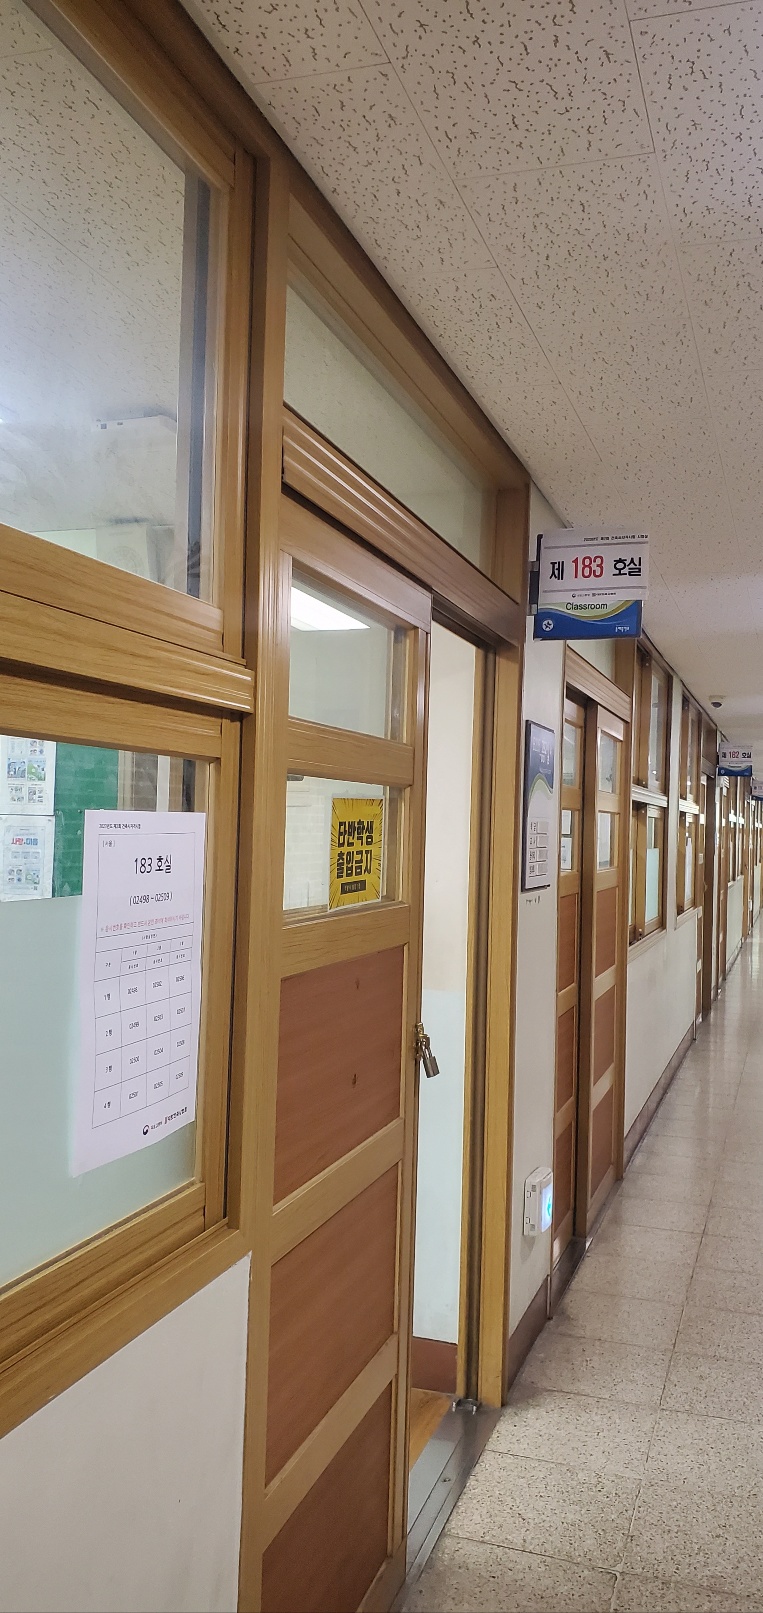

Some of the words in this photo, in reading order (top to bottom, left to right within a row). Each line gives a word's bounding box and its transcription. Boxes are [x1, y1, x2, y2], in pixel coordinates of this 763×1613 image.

[549, 561, 565, 580] 제
[571, 555, 604, 579] 183
[612, 557, 642, 577] 호실
[565, 602, 608, 611] Classroom
[338, 819, 374, 848] 타반학생
[134, 857, 153, 875] 183
[155, 853, 172, 874] 호실
[337, 850, 372, 879] 출입금지
